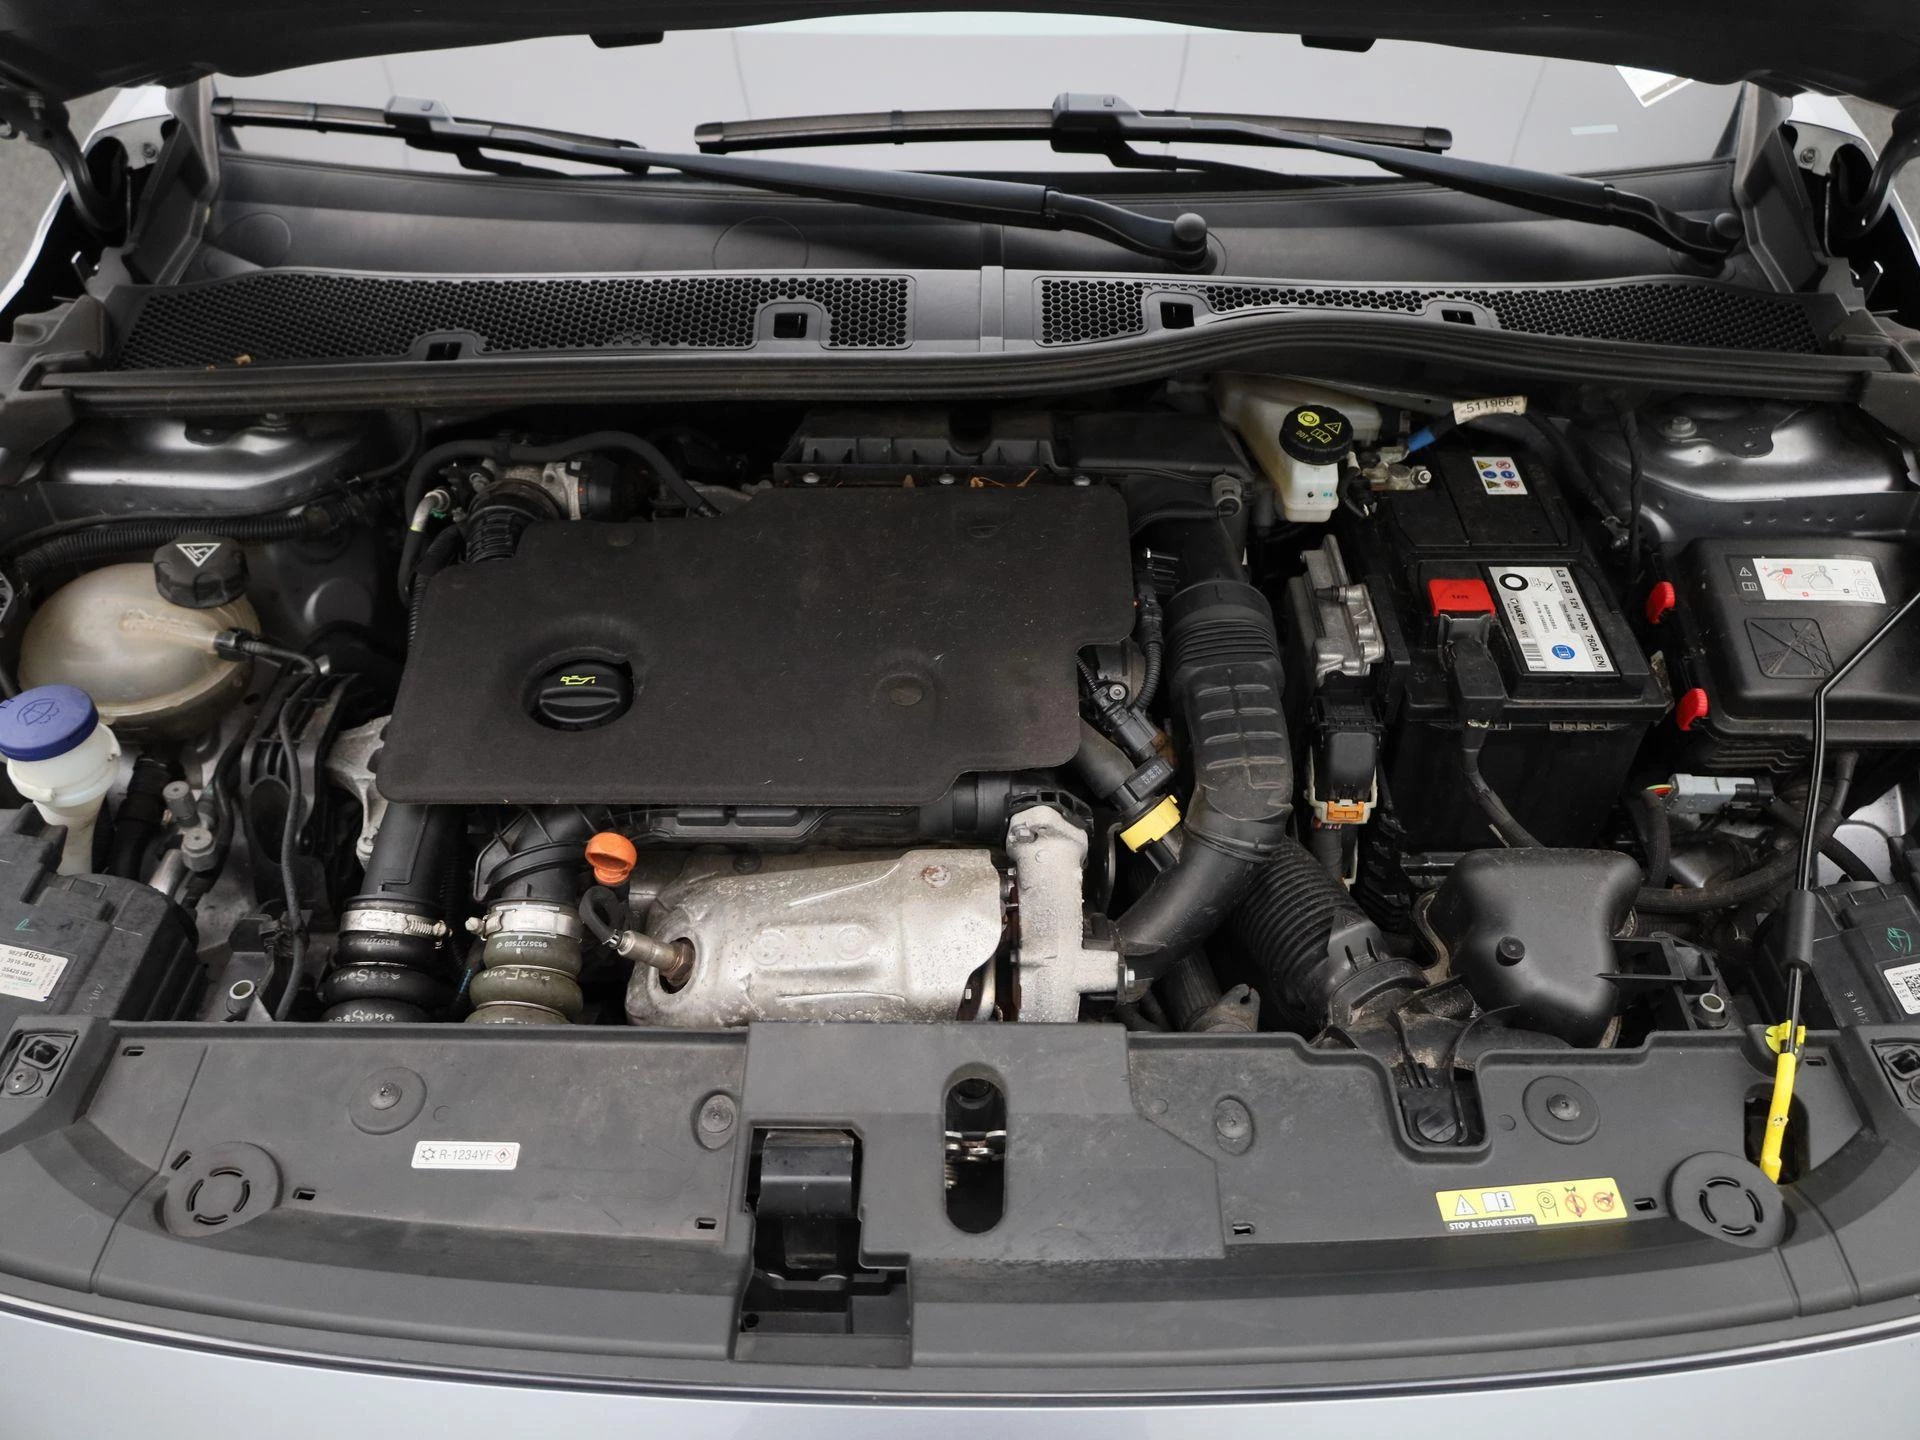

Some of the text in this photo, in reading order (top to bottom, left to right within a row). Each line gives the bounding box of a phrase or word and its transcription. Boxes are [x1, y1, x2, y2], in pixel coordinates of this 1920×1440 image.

[1561, 581, 1573, 594] EFB
[1569, 598, 1581, 609] 12V
[1513, 605, 1527, 625] VARTA
[1576, 613, 1588, 631] 70Ah
[1585, 634, 1600, 652] 760A
[1592, 653, 1607, 668] (EN)
[439, 1149, 493, 1161] R-1234YF
[1448, 1216, 1535, 1230] STOP & START SYSTEM
